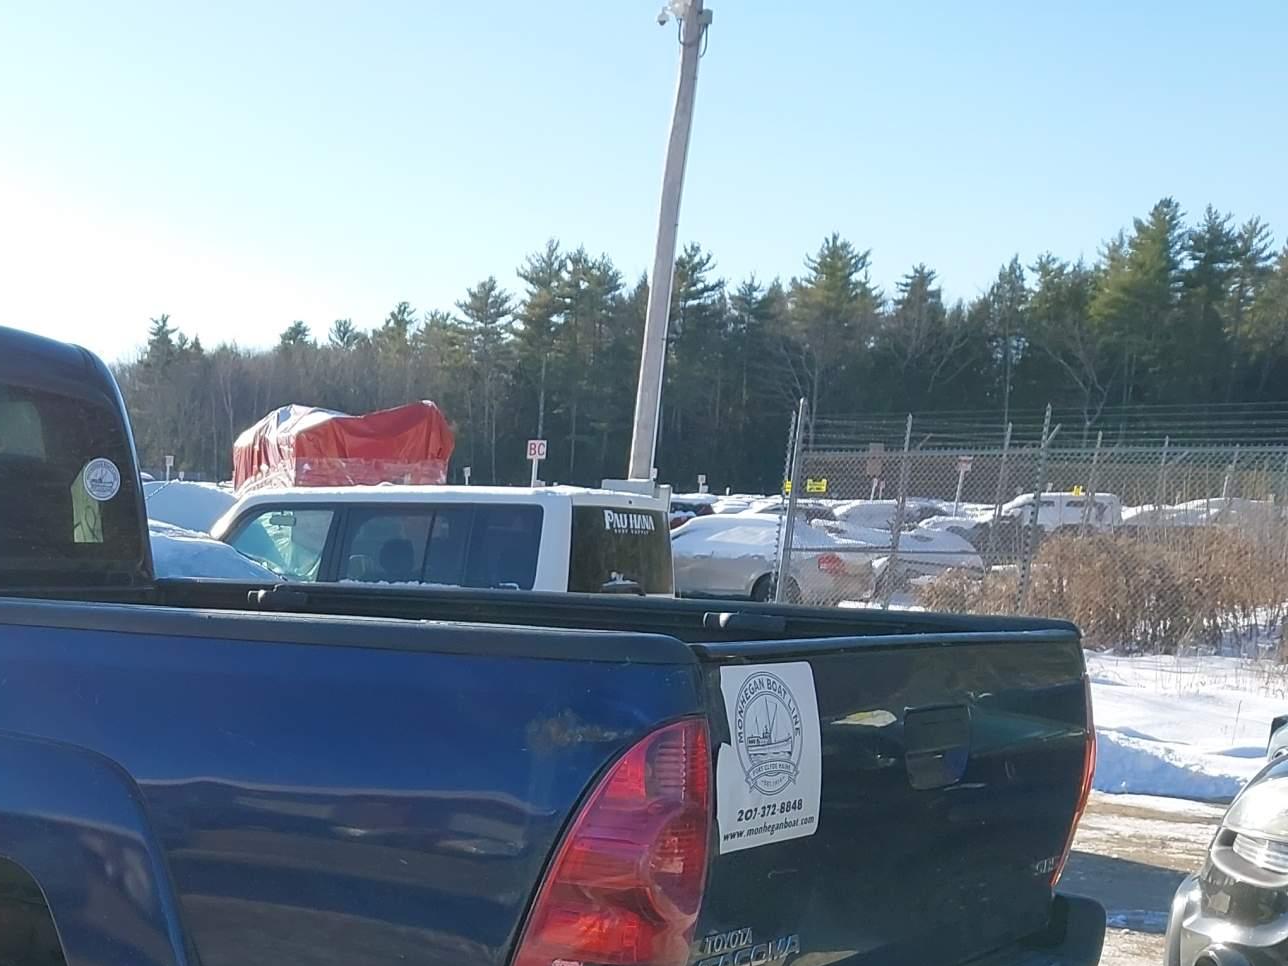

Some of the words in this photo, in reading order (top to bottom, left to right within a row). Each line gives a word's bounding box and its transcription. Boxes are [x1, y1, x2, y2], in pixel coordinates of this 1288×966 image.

[528, 442, 546, 456] BC
[603, 509, 628, 529] PAU
[629, 513, 655, 531] HANA
[737, 678, 765, 744] MONHEGAN
[765, 677, 787, 700] BOAT
[787, 697, 801, 737] LINE
[723, 815, 815, 842] www.monheganboat.com
[703, 927, 753, 955] TOYOTA
